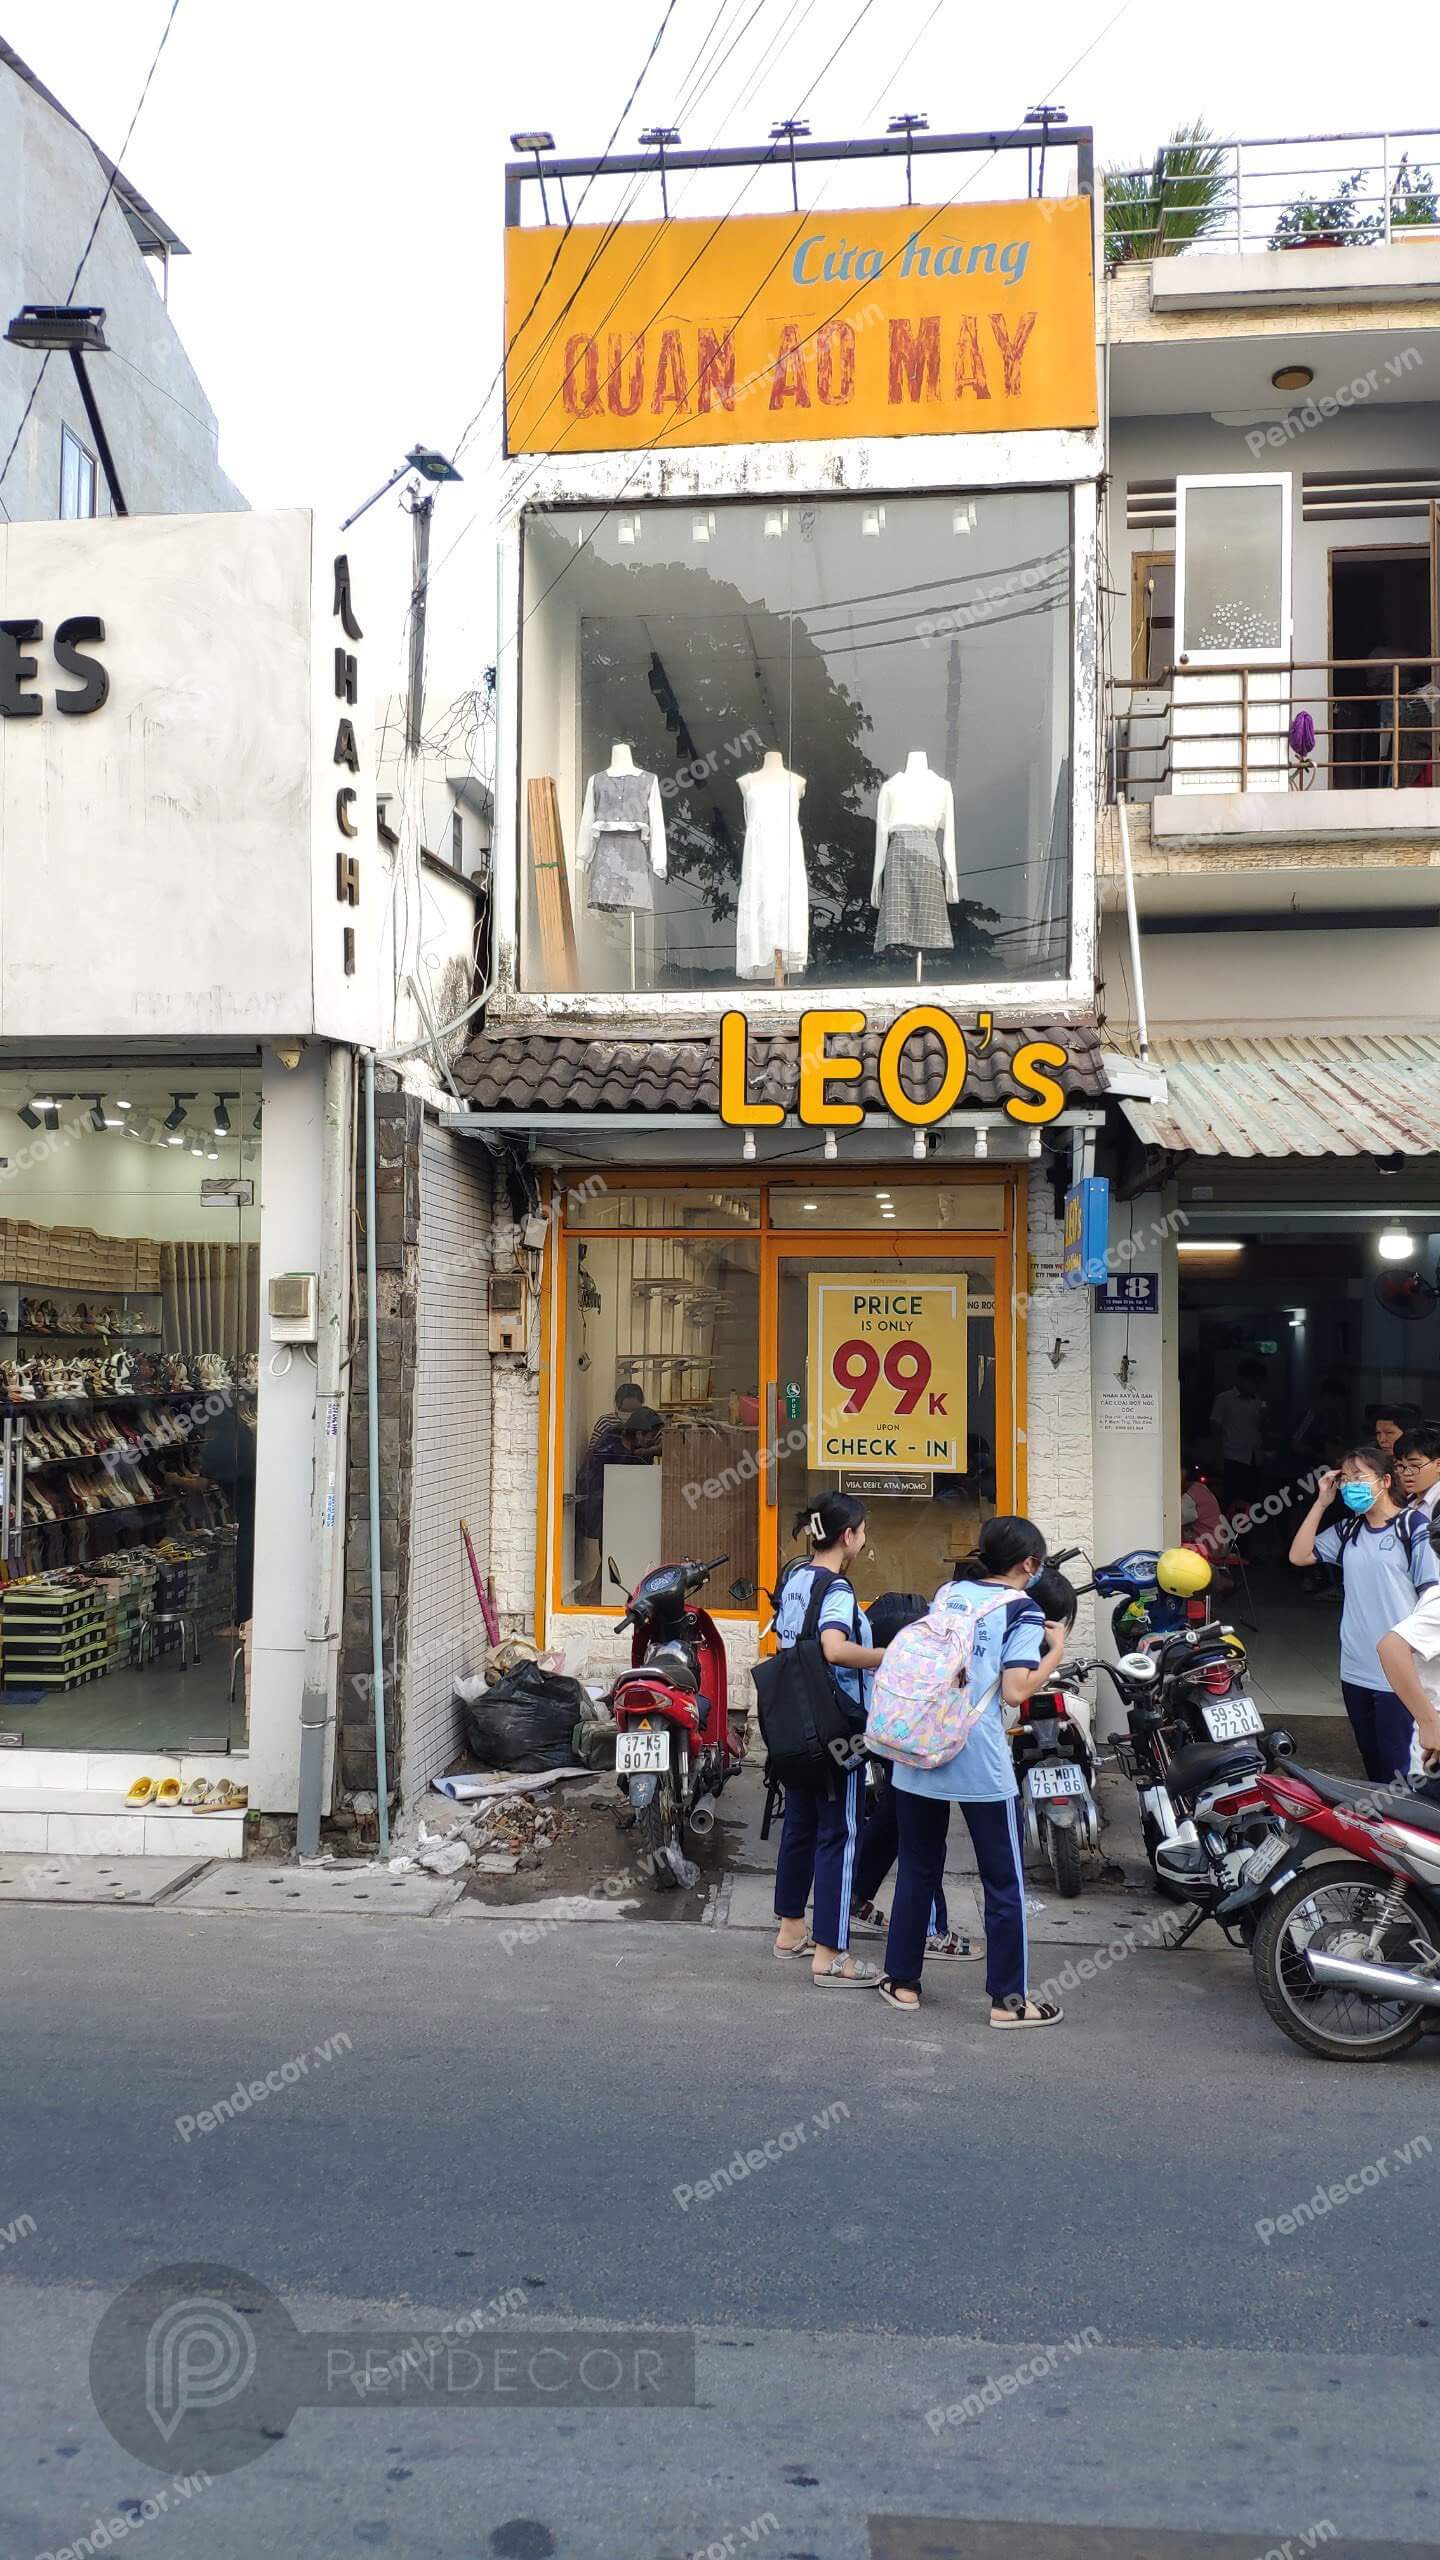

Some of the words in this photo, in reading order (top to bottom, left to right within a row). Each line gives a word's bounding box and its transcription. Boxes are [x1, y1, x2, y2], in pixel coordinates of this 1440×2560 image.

[900, 230, 1031, 286] hàng
[887, 311, 1039, 406] MAY
[0, 615, 110, 719] ES
[1103, 1276, 1151, 1298] 18
[854, 1296, 923, 1315] PRICE
[860, 1320, 872, 1331] IS
[877, 1320, 914, 1332] ONLY
[876, 1424, 901, 1432] UPON
[826, 1438, 898, 1457] CHECK
[926, 1440, 949, 1458] IN
[1210, 1702, 1250, 1724] 59-S1
[1211, 1714, 1261, 1740] 272.04
[624, 1751, 661, 1769] 9071
[1033, 1779, 1082, 1796] 761.86
